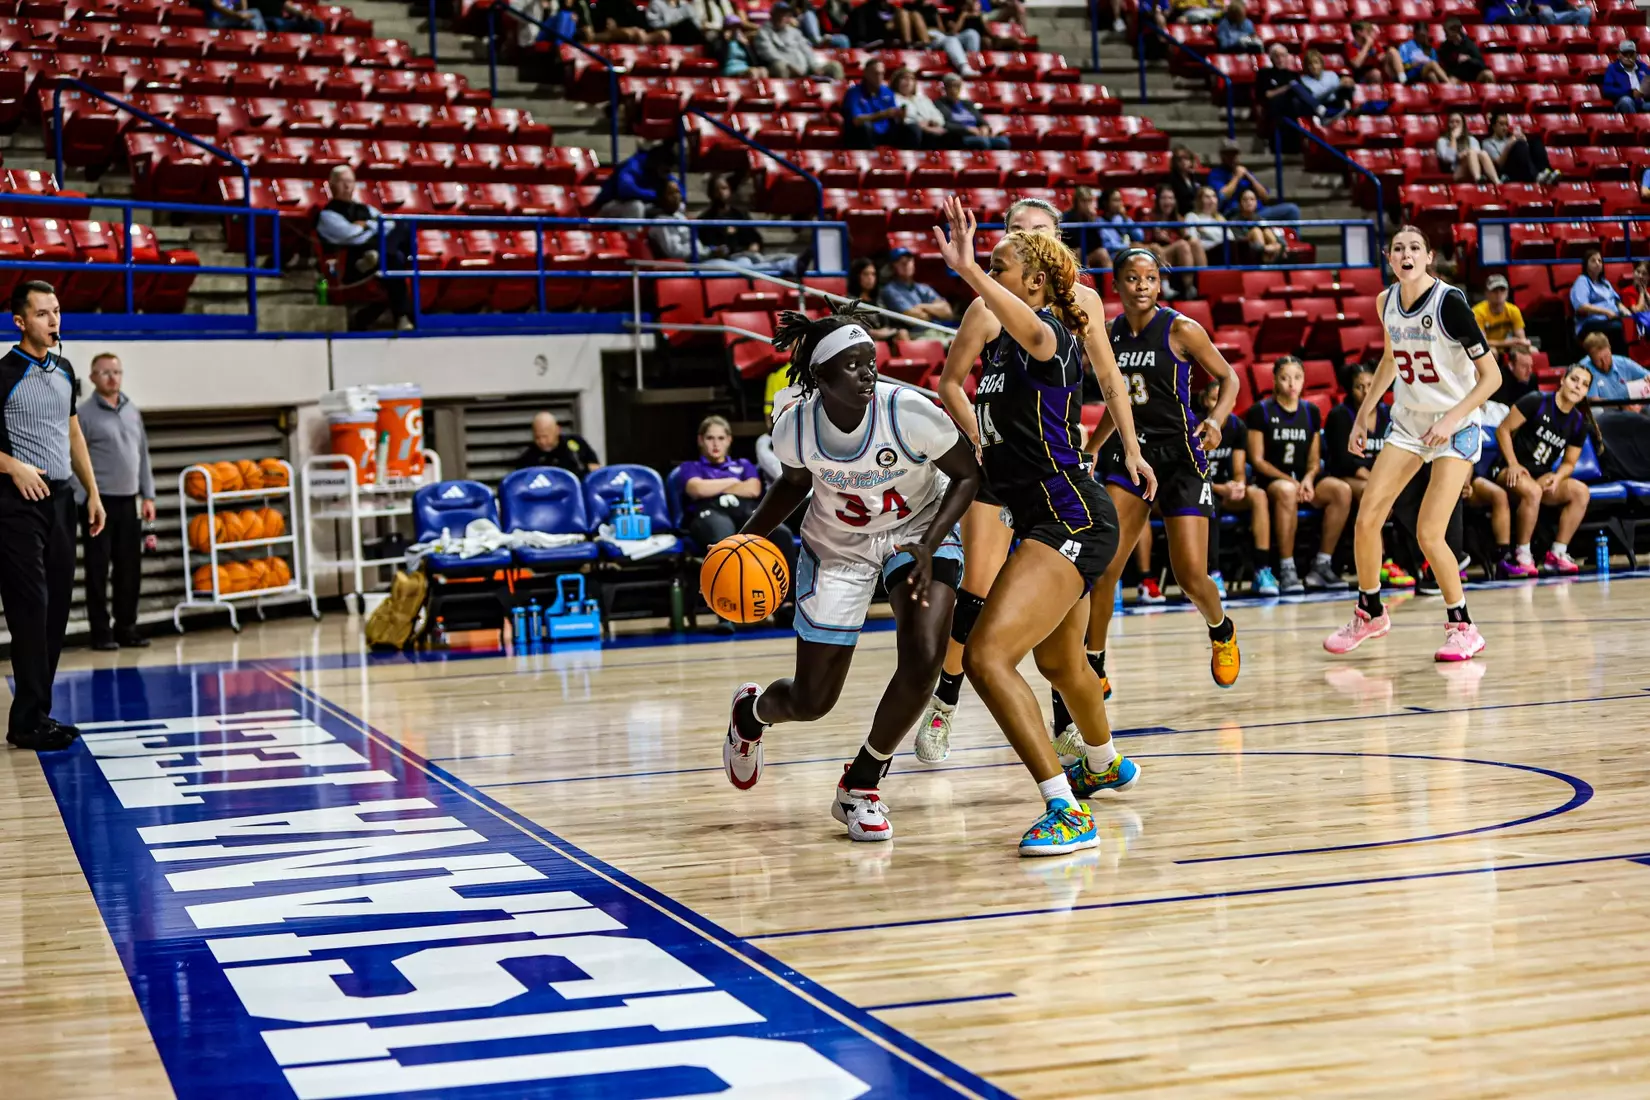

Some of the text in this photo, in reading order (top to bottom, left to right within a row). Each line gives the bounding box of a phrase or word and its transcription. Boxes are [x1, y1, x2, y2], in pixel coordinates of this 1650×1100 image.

[1117, 350, 1156, 367] SUA
[1393, 350, 1440, 385] 33
[977, 373, 1005, 394] SUA
[977, 402, 1004, 447] 14
[1273, 428, 1307, 440] LSUA
[1283, 443, 1295, 464] 2
[820, 467, 908, 490] Lady Techsters
[835, 486, 912, 526] 34
[74, 708, 397, 808] TECH
